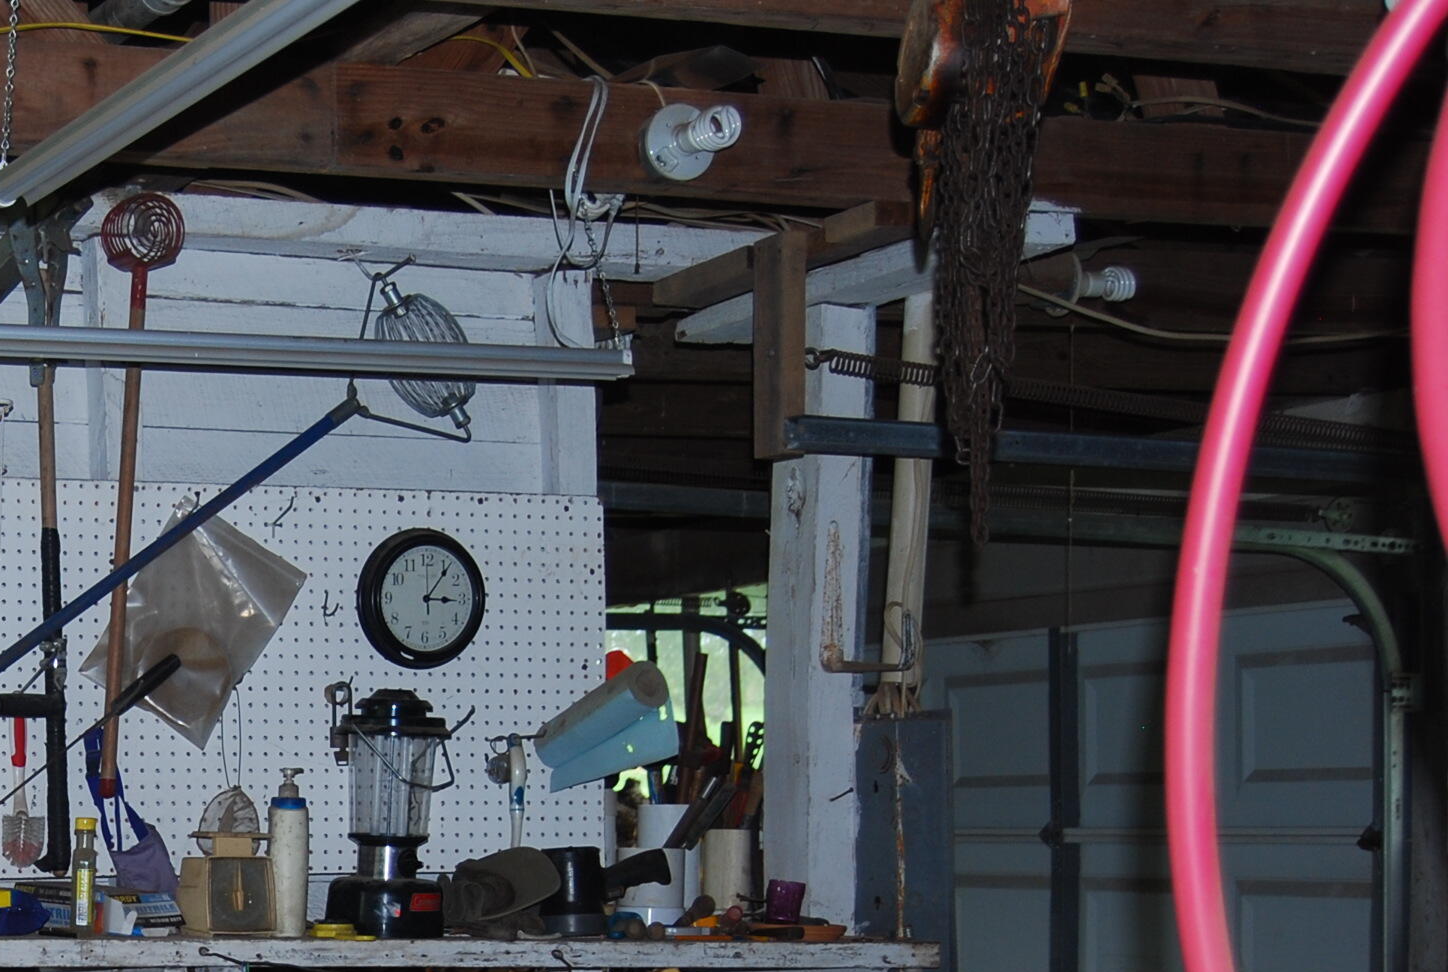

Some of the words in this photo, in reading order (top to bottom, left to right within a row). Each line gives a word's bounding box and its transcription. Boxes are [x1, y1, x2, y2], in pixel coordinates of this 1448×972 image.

[404, 559, 416, 572] 11
[420, 553, 434, 567] 12
[391, 573, 404, 586] 10
[452, 574, 460, 587] 2
[384, 592, 393, 604] 9
[457, 592, 466, 605] 3
[390, 612, 399, 624] 8
[451, 612, 459, 625] 4
[404, 626, 412, 639] 7
[420, 631, 429, 644] 6
[438, 626, 447, 639] 5
